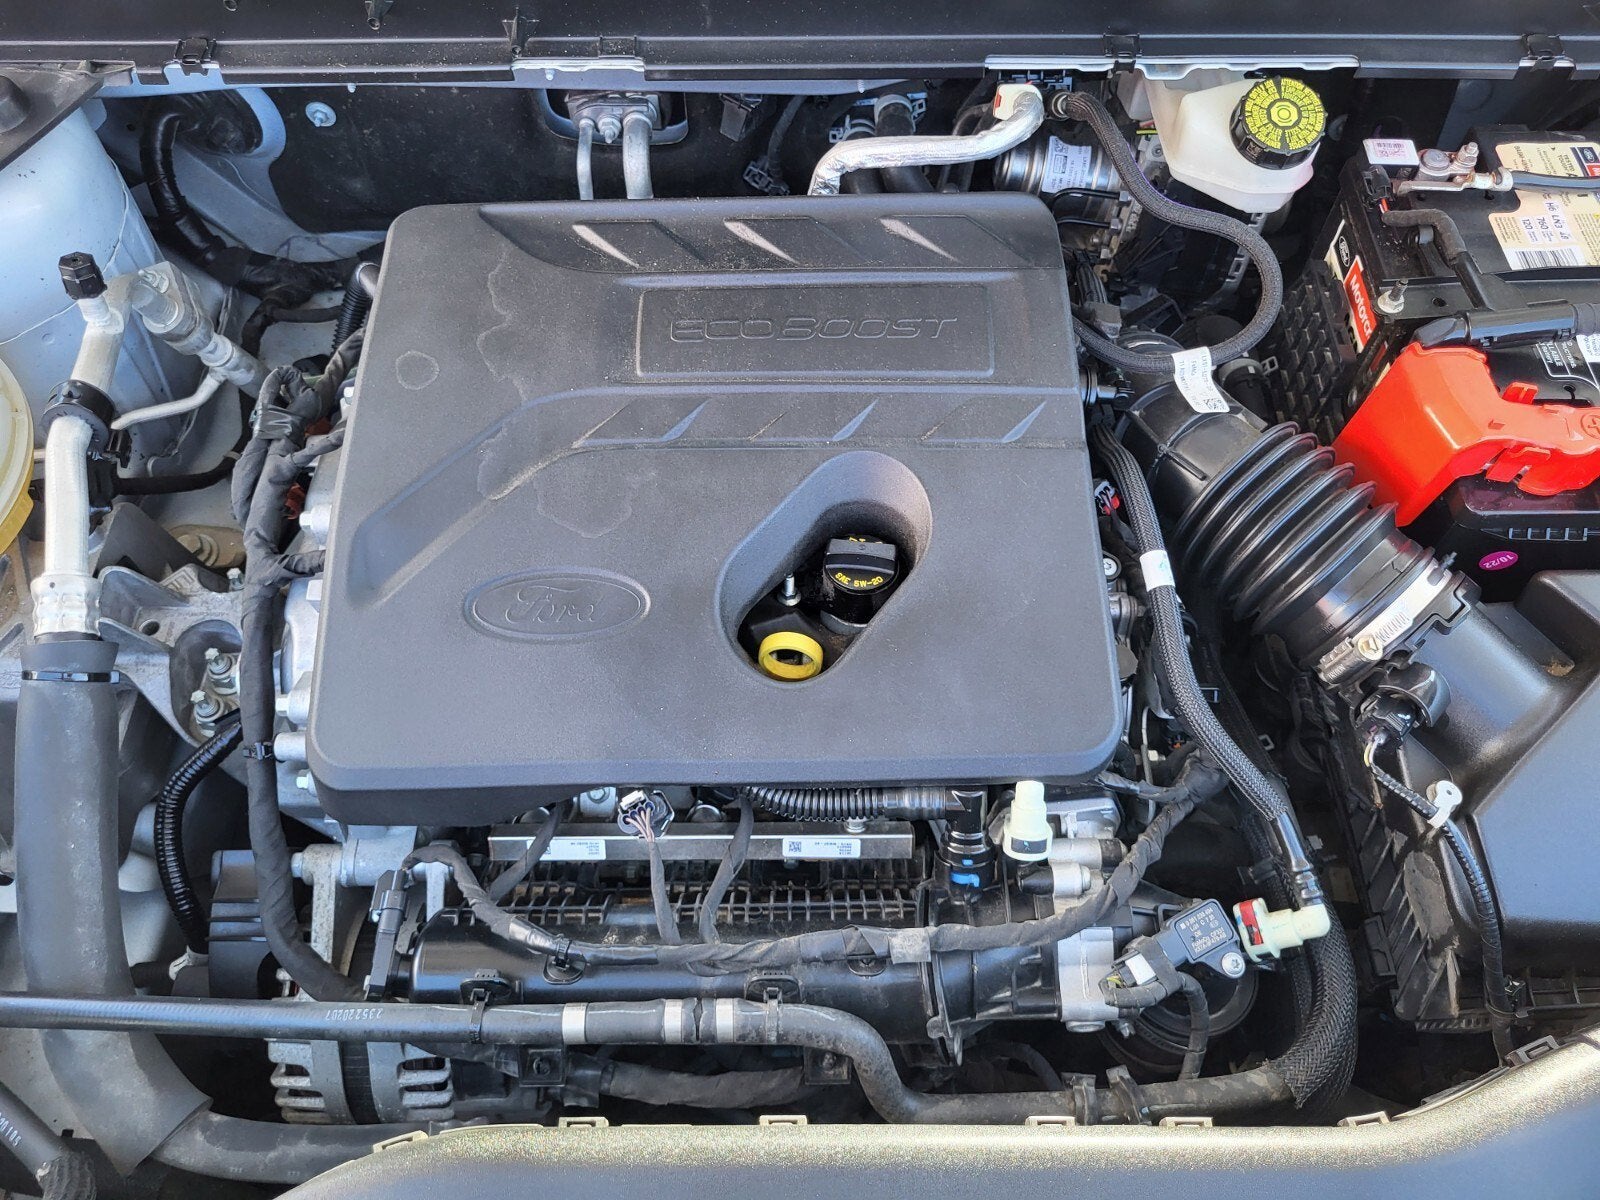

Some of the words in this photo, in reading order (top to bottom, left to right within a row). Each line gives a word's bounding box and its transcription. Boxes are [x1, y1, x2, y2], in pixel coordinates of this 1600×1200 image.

[1546, 202, 1556, 211] H6
[1552, 214, 1563, 228] LN3
[1523, 219, 1532, 229] 120
[1537, 217, 1549, 229] 760
[670, 317, 958, 343] ECOBOOST
[1483, 555, 1513, 568] 10/22
[835, 573, 851, 585] SAE
[853, 576, 883, 587] 5W-20
[505, 584, 602, 624] Ford
